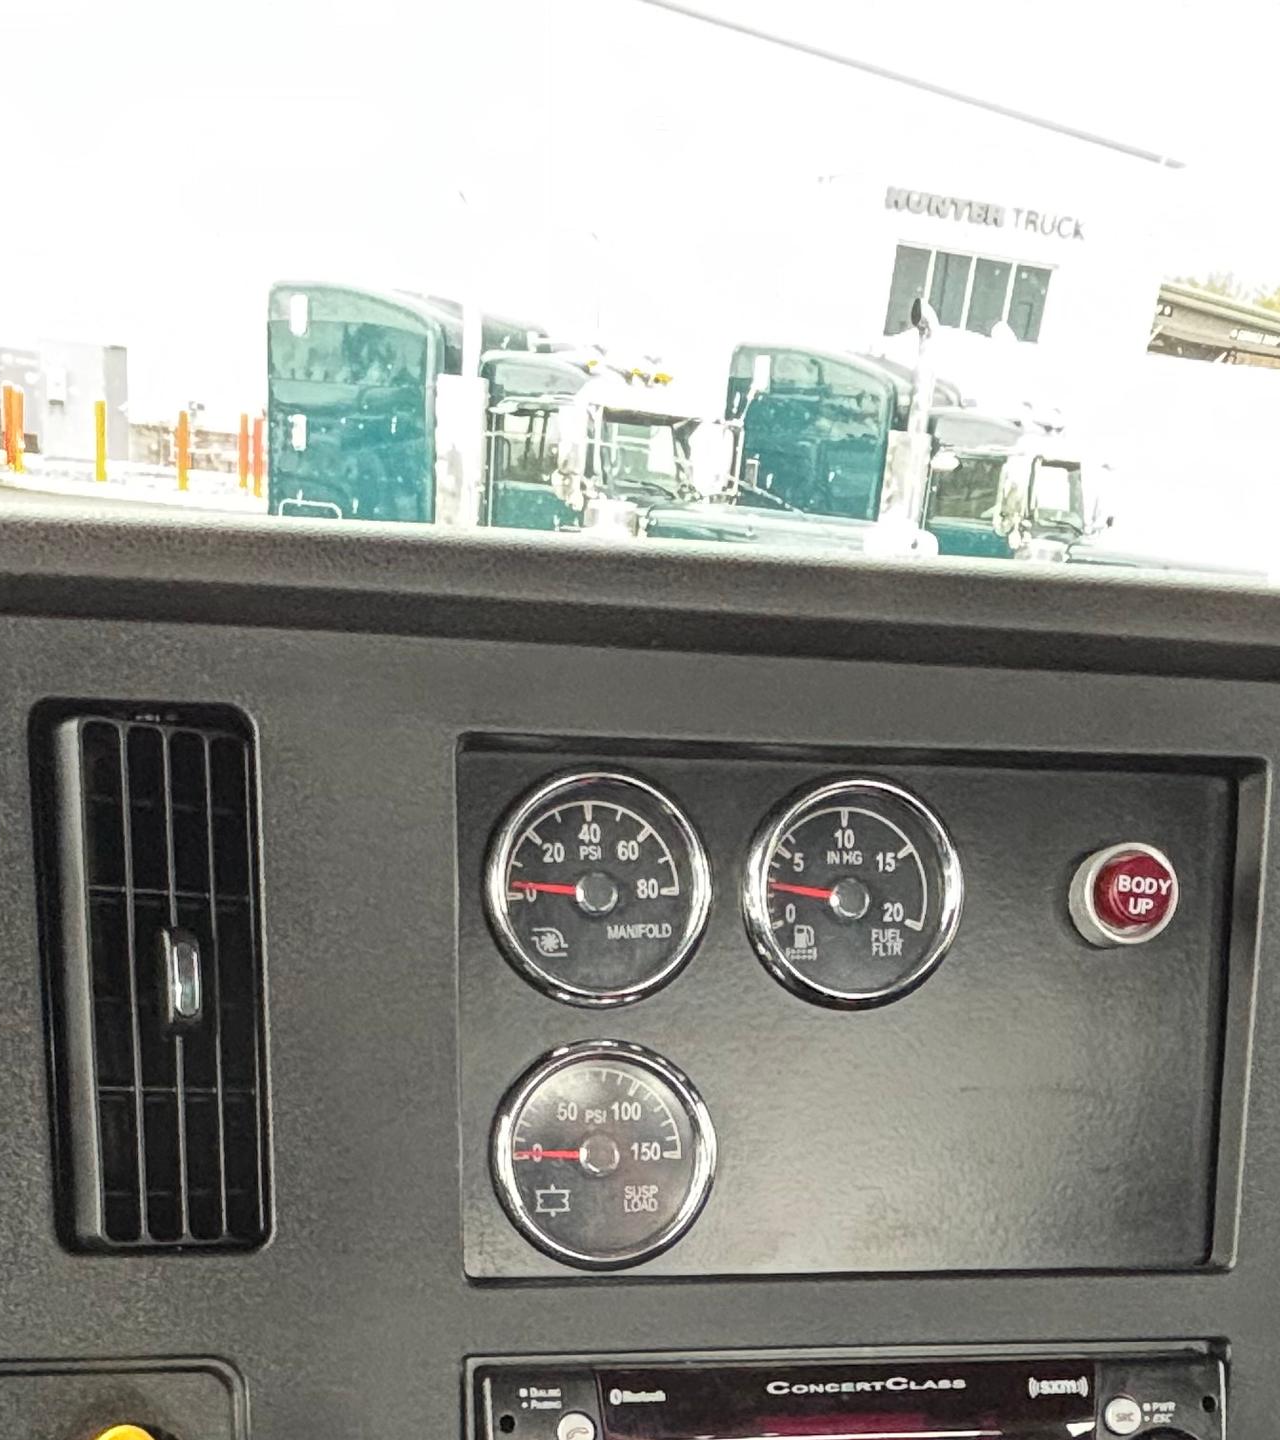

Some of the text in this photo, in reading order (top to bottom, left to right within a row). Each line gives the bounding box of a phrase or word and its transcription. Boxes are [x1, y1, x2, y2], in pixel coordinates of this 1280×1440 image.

[884, 186, 1085, 240] HUNTER TRUCK
[578, 825, 602, 844] 40
[834, 829, 856, 848] 10
[541, 843, 565, 863] 20
[578, 845, 602, 861] PSI
[616, 842, 640, 862] 60
[791, 854, 805, 872] 5
[875, 853, 897, 872] 15
[635, 880, 659, 899] 80
[1116, 874, 1172, 896] BODY
[785, 903, 797, 923] 0
[882, 903, 905, 922] 20
[1128, 897, 1154, 915] UP
[607, 924, 672, 940] MANIFOLD
[871, 930, 904, 944] FUEL
[870, 943, 903, 957] FLTR
[557, 1103, 579, 1123] 50
[585, 1109, 608, 1125] PSI
[611, 1102, 642, 1122] 100
[630, 1141, 662, 1162] 150
[624, 1185, 659, 1200] SUSP
[623, 1197, 658, 1213] LOAD
